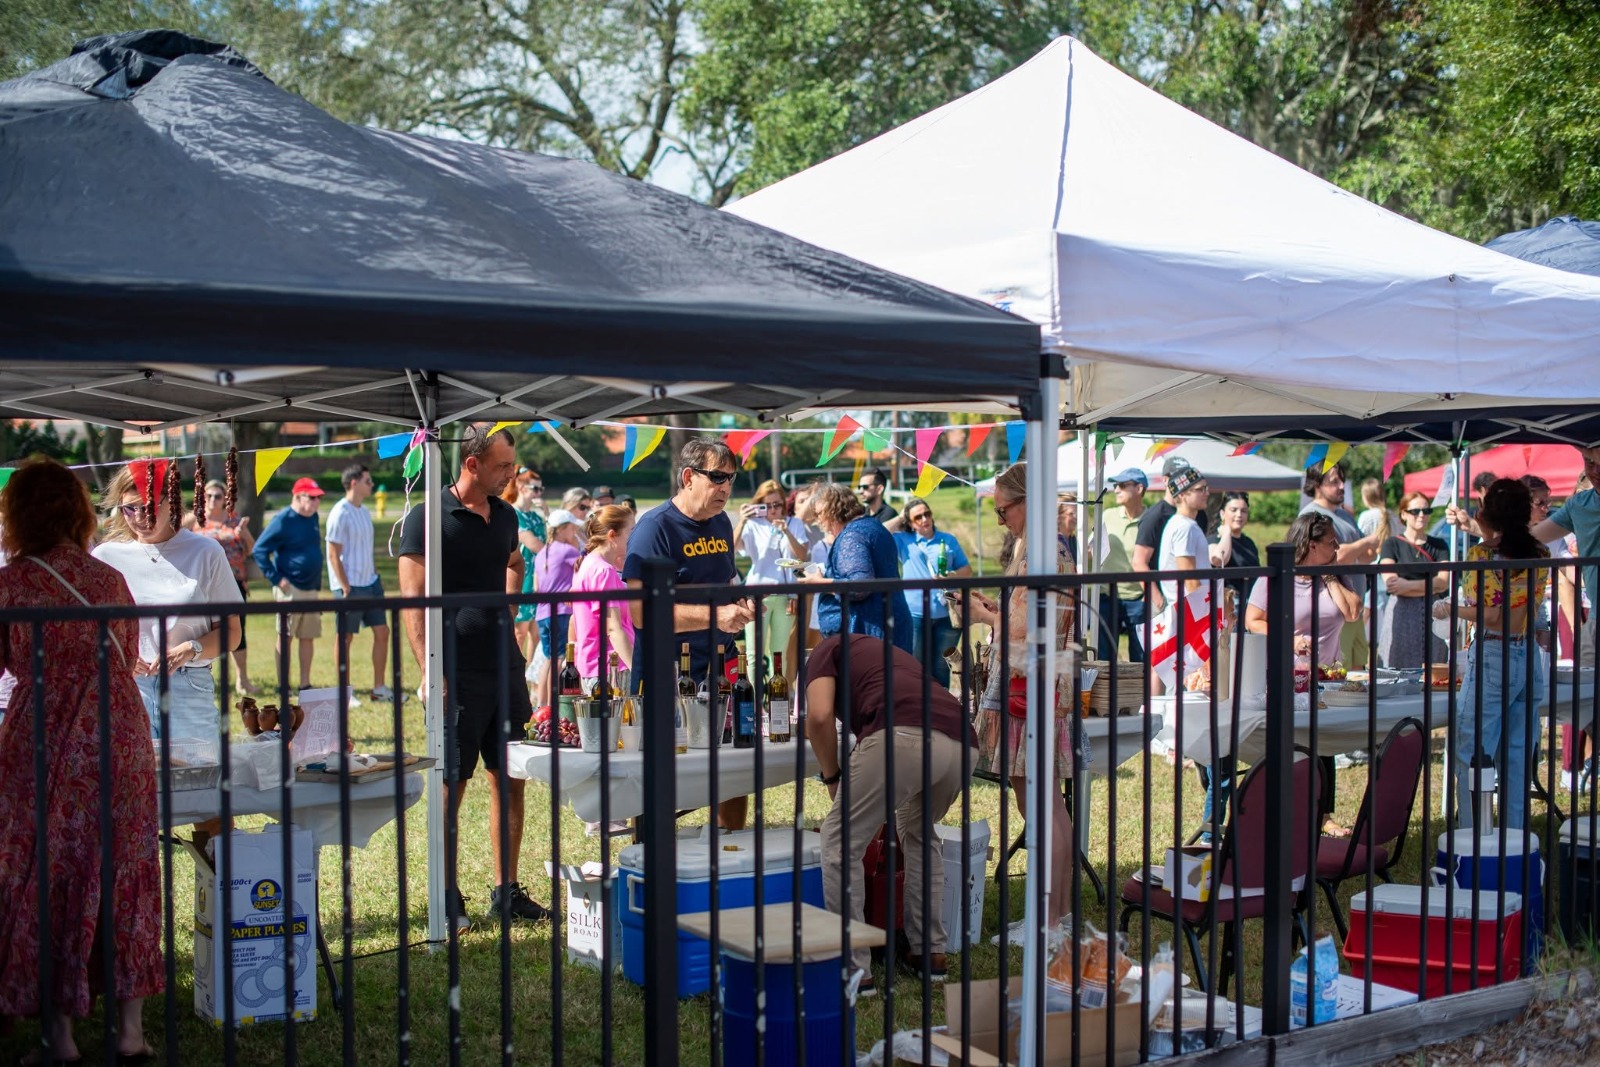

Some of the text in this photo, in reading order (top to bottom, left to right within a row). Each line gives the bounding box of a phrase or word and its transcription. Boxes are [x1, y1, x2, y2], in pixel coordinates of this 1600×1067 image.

[683, 536, 729, 557] adidas
[254, 899, 280, 909] SUNSET
[248, 915, 285, 924] UNCOATED
[570, 912, 602, 930] SILK
[230, 921, 306, 938] PAPER PLAES
[573, 927, 599, 938] ROAD
